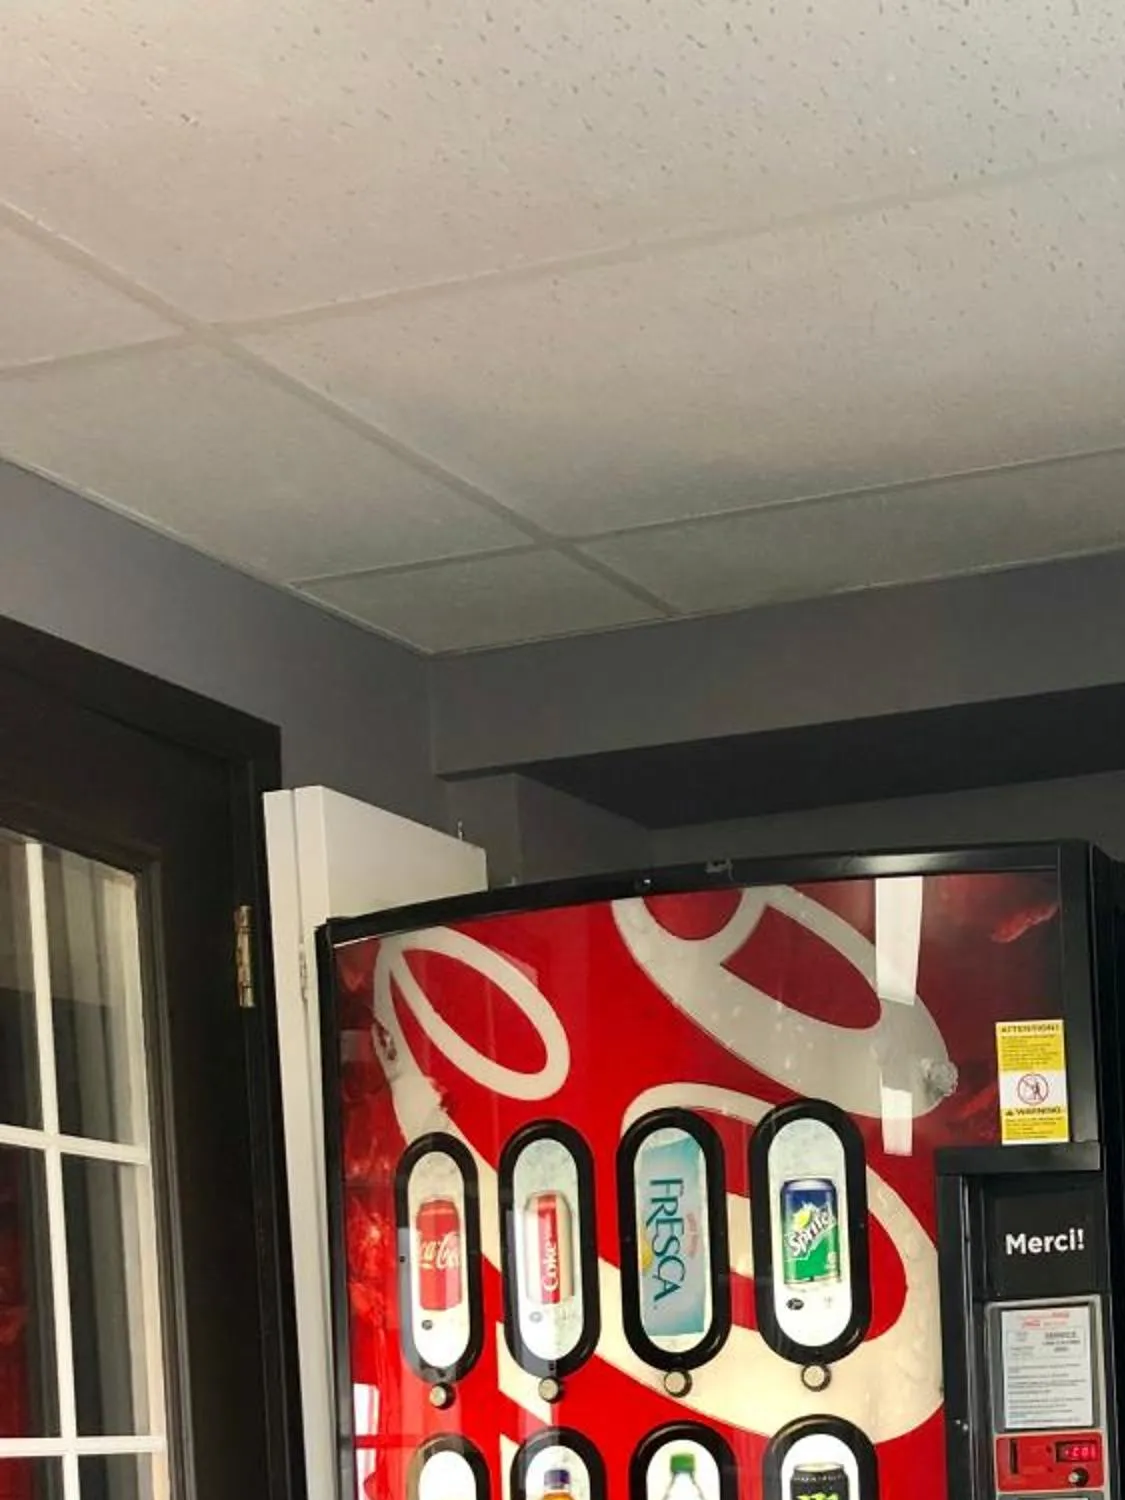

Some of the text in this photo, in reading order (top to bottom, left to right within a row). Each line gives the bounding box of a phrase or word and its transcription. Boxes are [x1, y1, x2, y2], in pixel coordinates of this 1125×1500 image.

[646, 1178, 686, 1302] FRESCA
[787, 1202, 834, 1257] Sprite
[1005, 1228, 1085, 1255] Merci!
[541, 1241, 559, 1292] Coke
